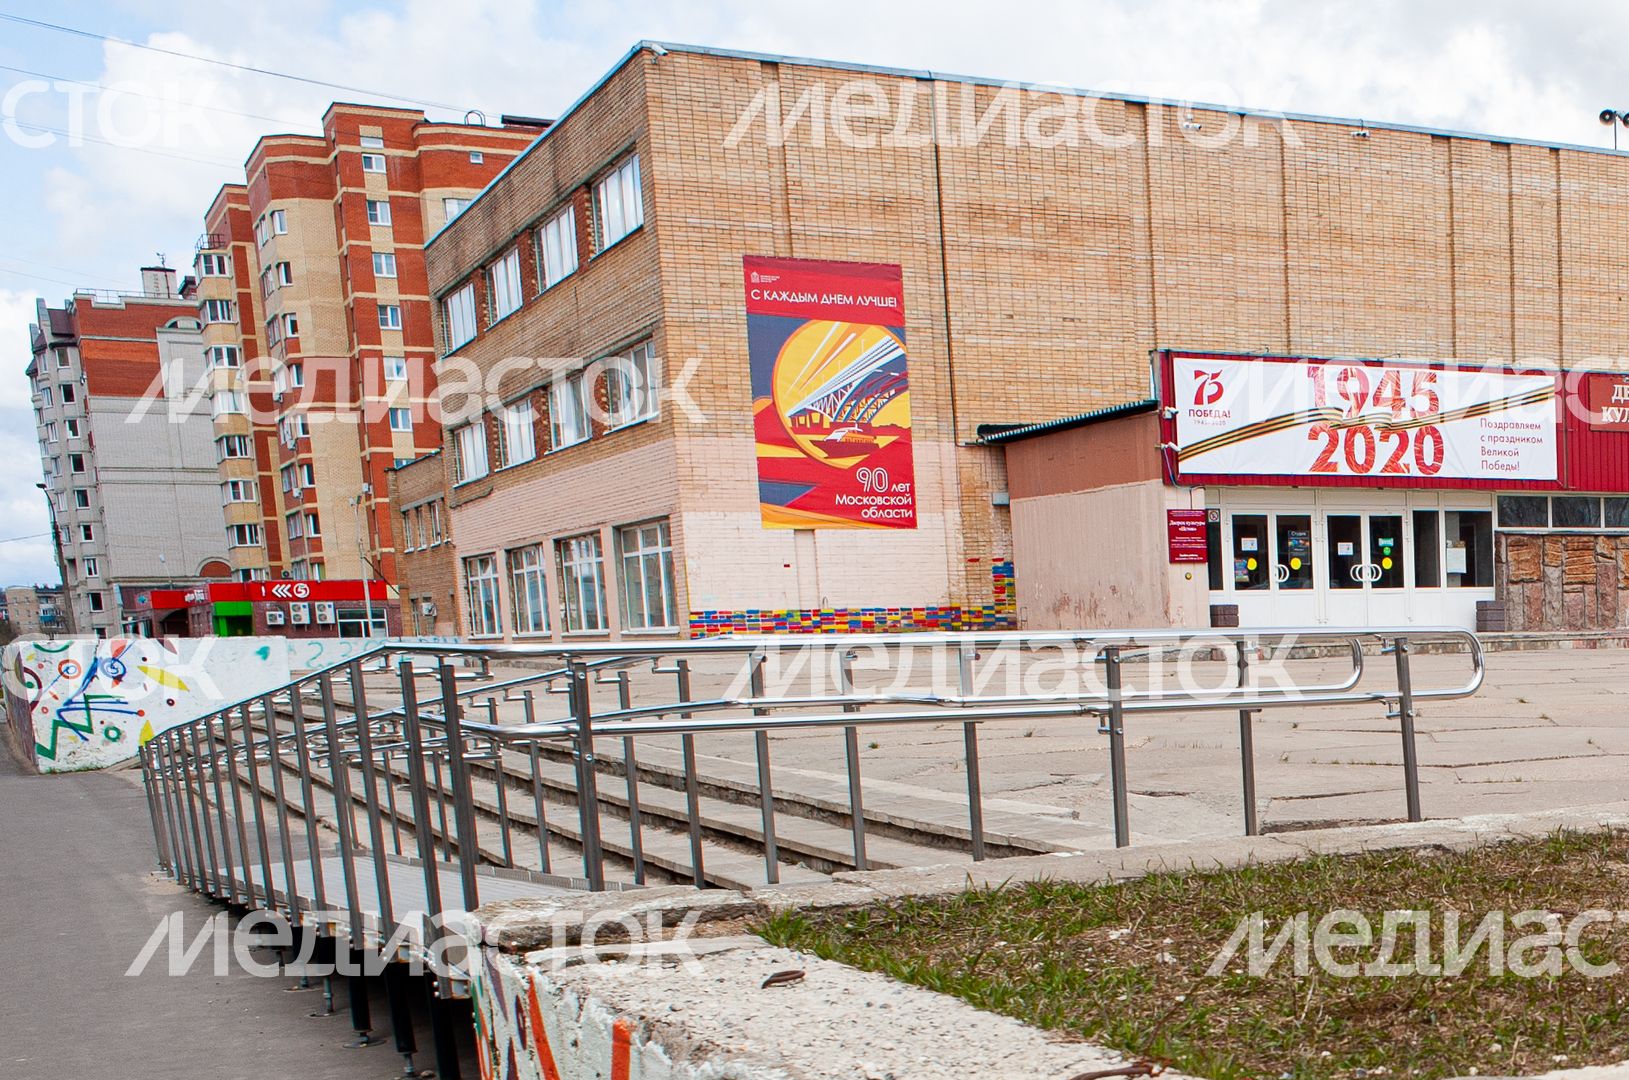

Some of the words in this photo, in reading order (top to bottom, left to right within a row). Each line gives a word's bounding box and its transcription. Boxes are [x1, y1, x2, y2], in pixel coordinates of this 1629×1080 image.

[751, 290, 761, 300] С
[763, 291, 818, 304] КАЖДЫМ
[821, 294, 853, 305] ДНЕМ
[856, 295, 897, 307] ЛУЧШЕ!
[1194, 370, 1224, 406] 75
[1307, 366, 1440, 419] 1945
[1188, 409, 1231, 418] ПОБЕДА!
[1480, 418, 1541, 431] Поздравляем
[1488, 435, 1543, 444] праздником
[1307, 425, 1444, 475] 2020
[1481, 446, 1519, 456] Великой
[1481, 460, 1520, 471] Победы!
[856, 467, 889, 492] 90
[891, 483, 910, 492] лет
[835, 494, 912, 505] Московской
[861, 507, 913, 518] области
